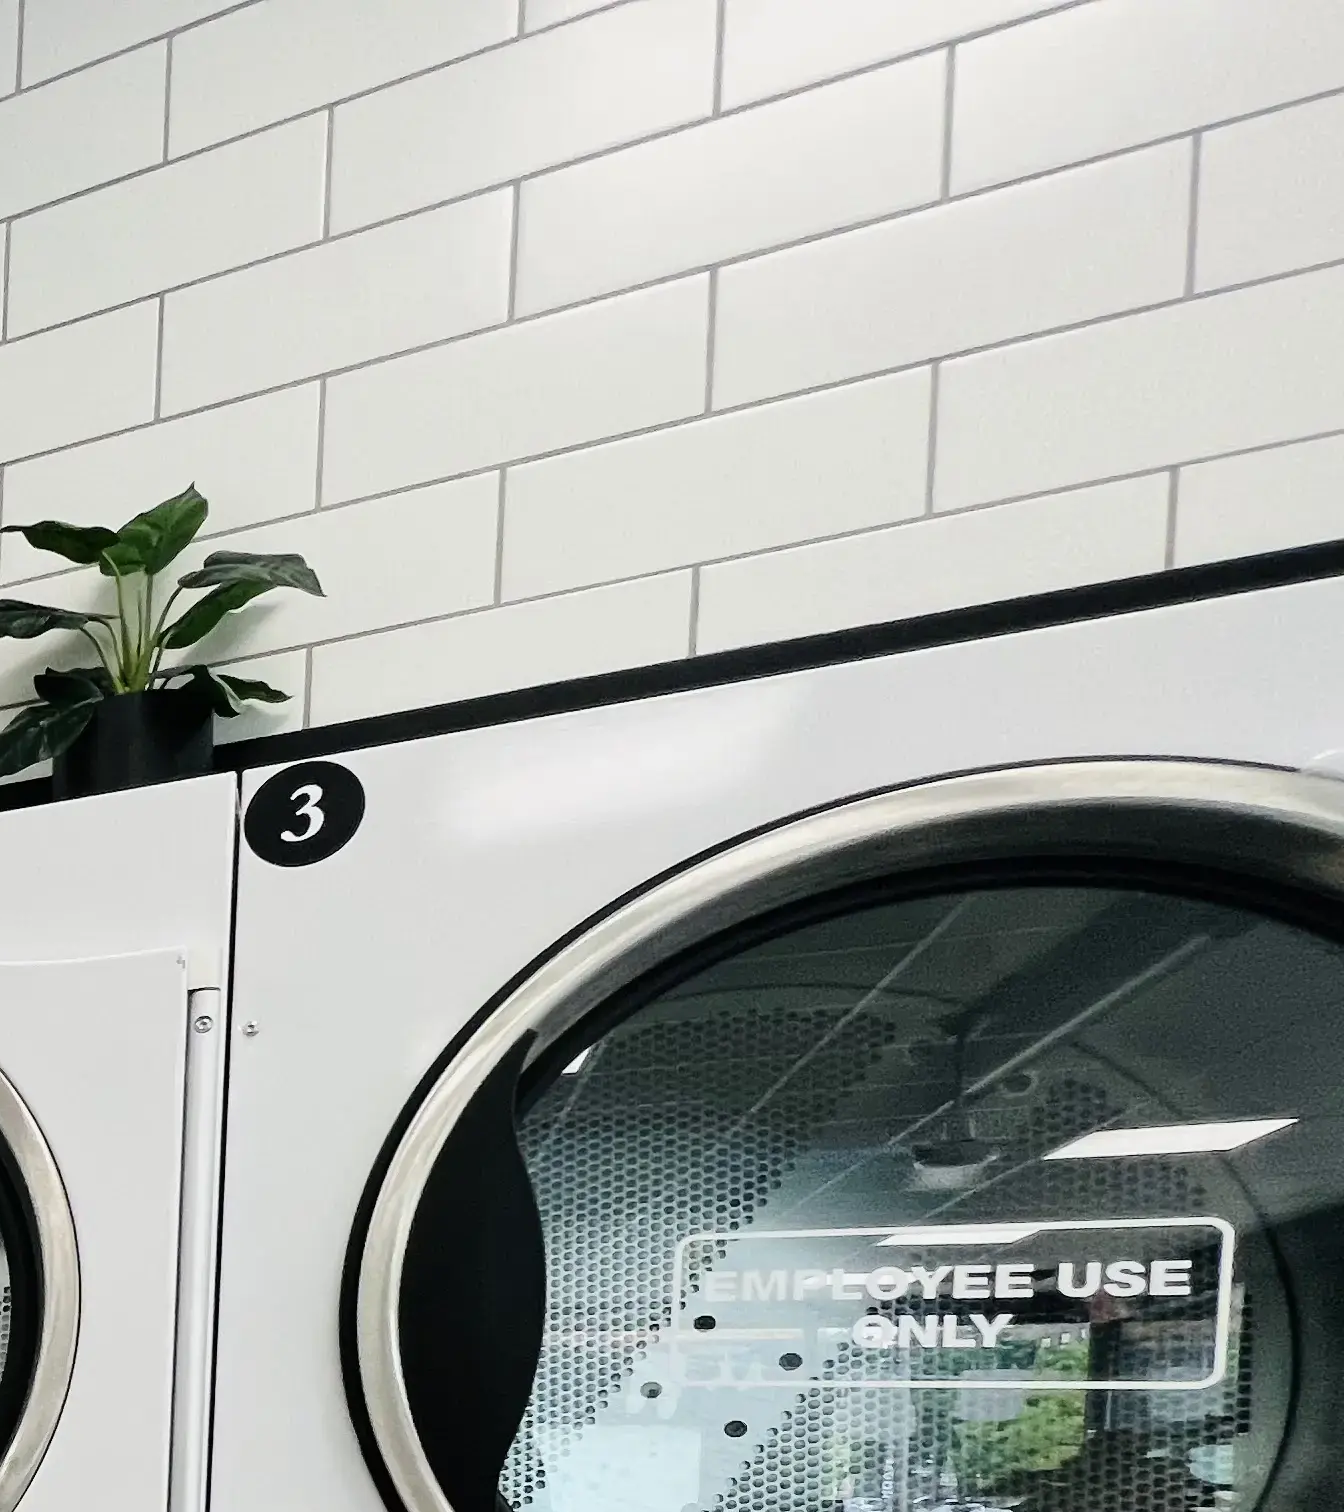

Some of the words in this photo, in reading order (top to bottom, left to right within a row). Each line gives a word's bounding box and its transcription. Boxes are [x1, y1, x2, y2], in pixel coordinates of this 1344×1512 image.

[278, 783, 324, 844] 3
[703, 1263, 1035, 1302] EMPLOYEE
[1057, 1259, 1193, 1299] USE
[852, 1313, 1014, 1350] ONLY
